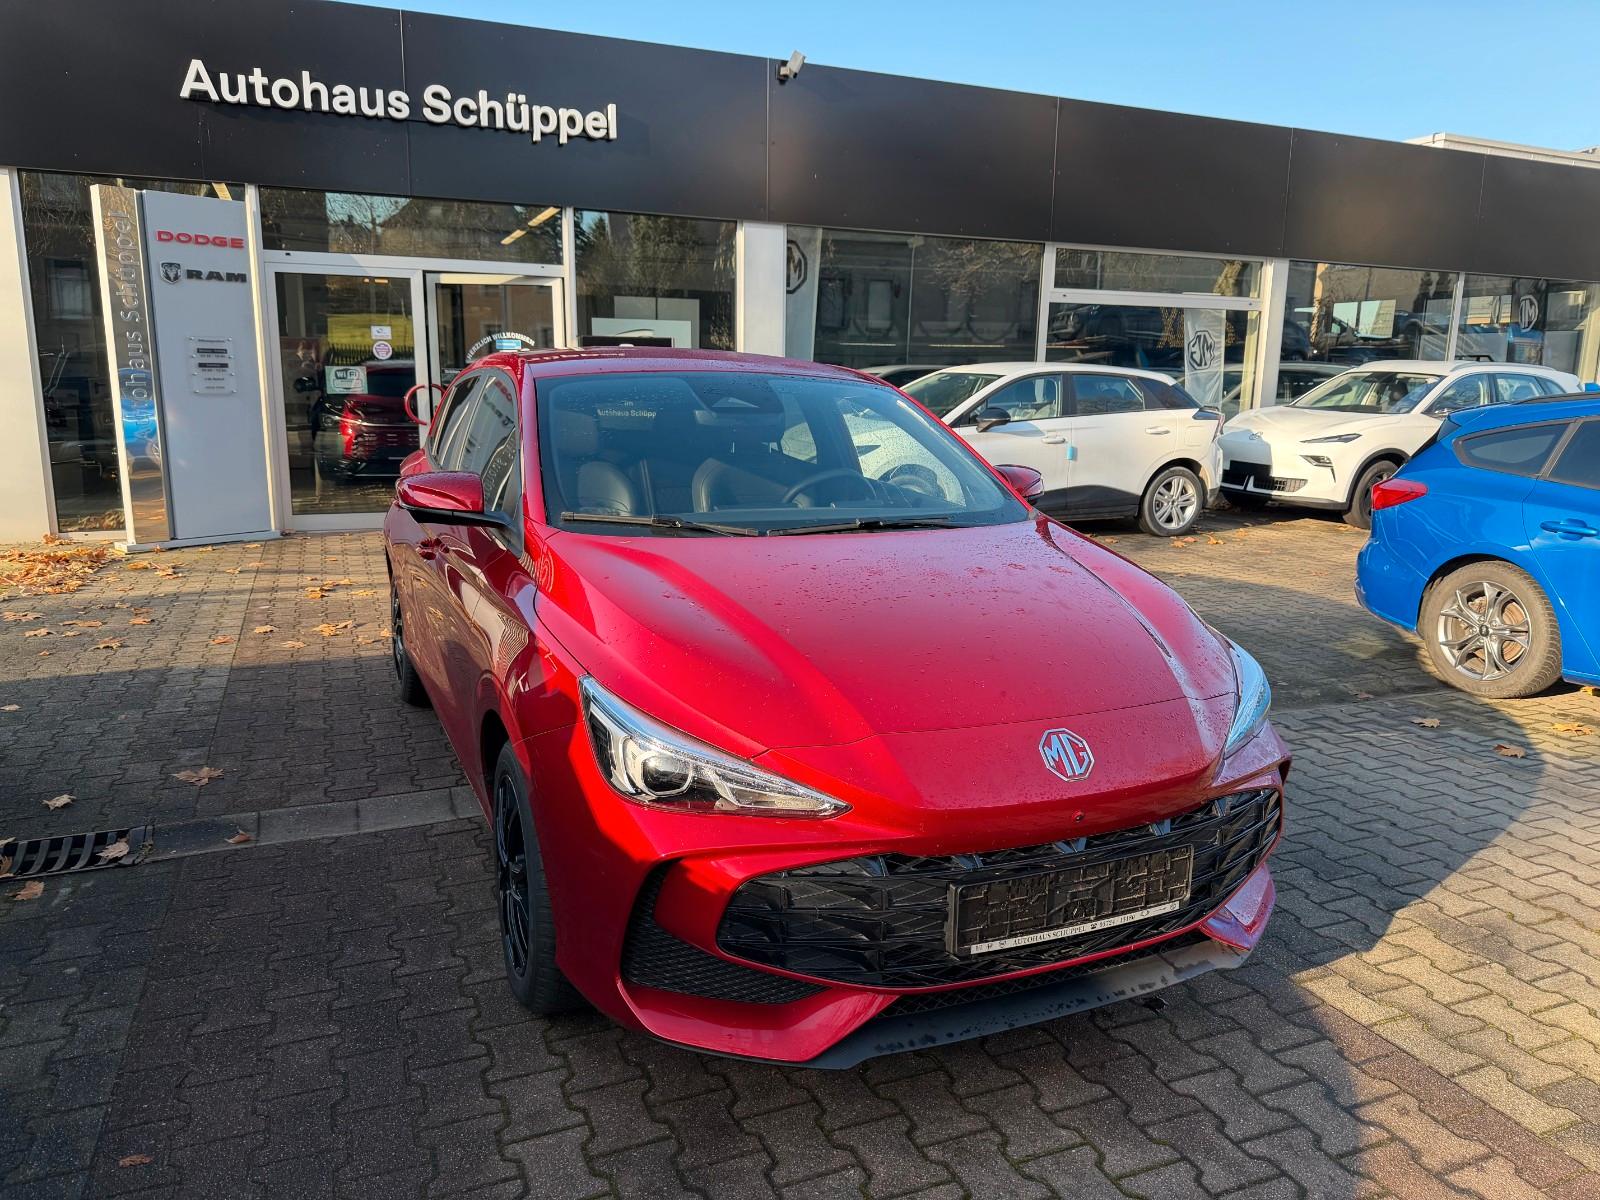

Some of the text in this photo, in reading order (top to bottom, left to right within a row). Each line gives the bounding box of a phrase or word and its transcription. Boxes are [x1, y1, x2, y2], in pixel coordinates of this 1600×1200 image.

[180, 59, 617, 144] Autohaus Schüppel
[156, 230, 244, 249] DODGE
[107, 210, 140, 323] Schüppel
[186, 269, 247, 283] RAM
[466, 331, 536, 361] HERZLICH WILLKOMMEN
[1042, 732, 1090, 778] MG
[1012, 932, 1052, 946] AUTOHAUS
